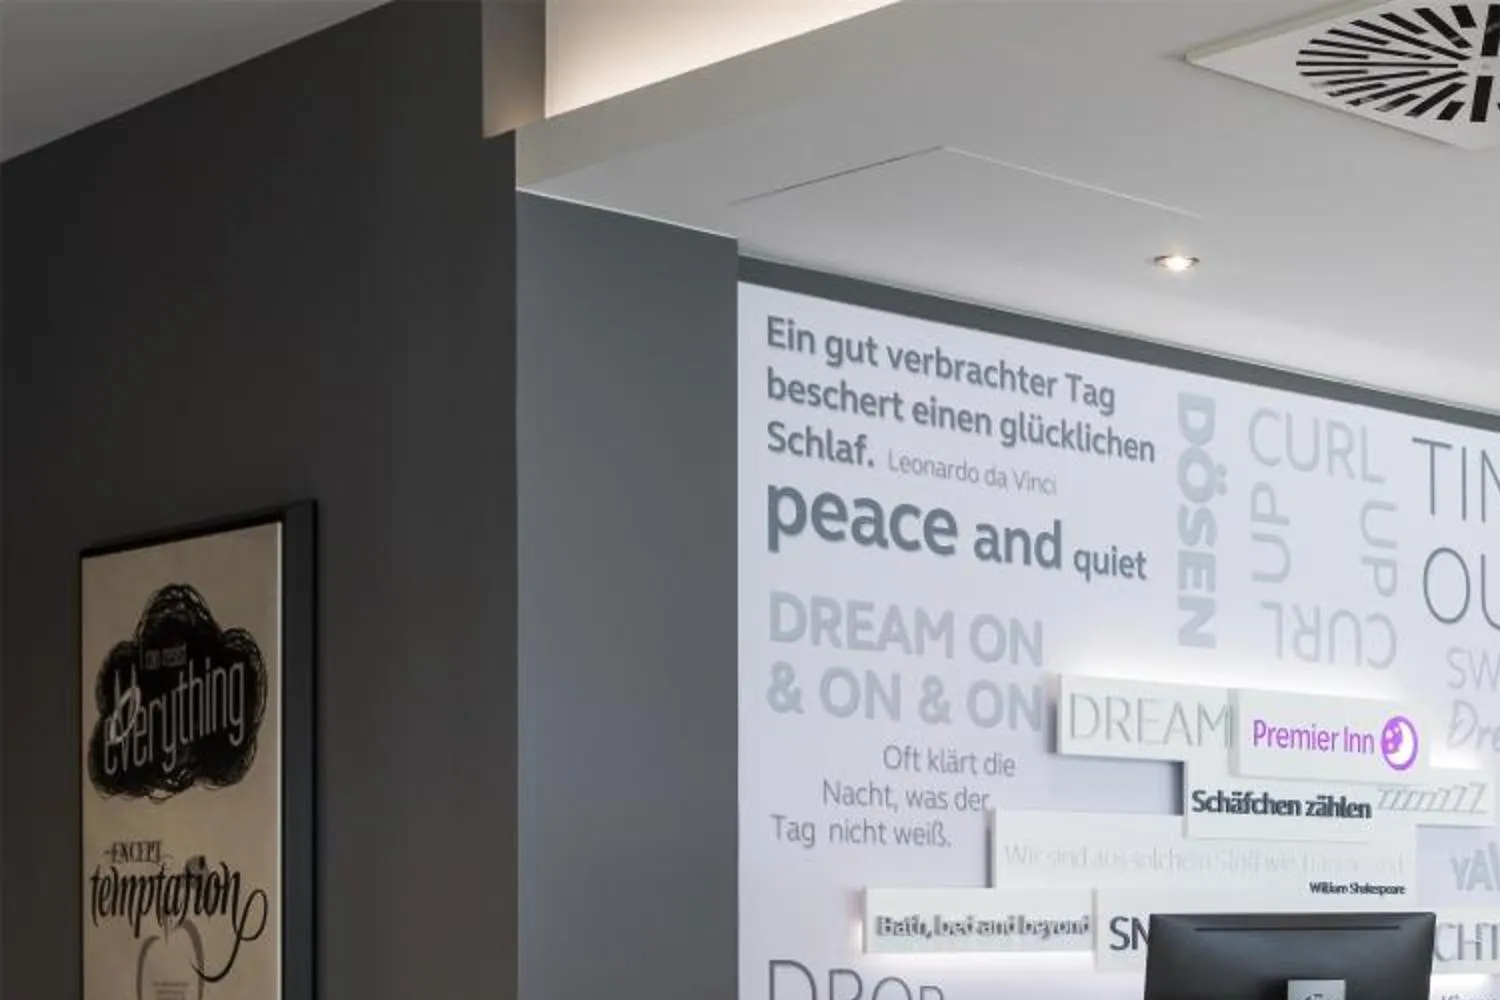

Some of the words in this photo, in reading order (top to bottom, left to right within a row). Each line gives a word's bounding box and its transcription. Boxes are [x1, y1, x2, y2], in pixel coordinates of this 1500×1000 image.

[767, 315, 815, 355] Ein
[825, 336, 879, 367] gut
[887, 347, 1057, 398] verbrachter
[1065, 373, 1115, 415] Tag
[767, 368, 903, 422] beschert
[913, 398, 992, 436] einen
[1000, 412, 1155, 463] glücklichen
[1248, 408, 1387, 484] CURL
[767, 421, 875, 468] Schlaf.
[888, 449, 979, 485] Leonardo
[985, 468, 1008, 489] da
[1013, 472, 1057, 495] Vinci
[767, 484, 957, 556] peace
[973, 520, 1062, 569] and
[1073, 546, 1147, 583] quiet
[1178, 393, 1229, 649] DÖSEN
[1250, 481, 1291, 584] UP
[1360, 499, 1398, 597] UP
[769, 590, 954, 658] DREAM
[969, 615, 1043, 667] ON
[1260, 600, 1398, 669] CURL
[104, 658, 245, 775] everything
[767, 661, 804, 715] &
[820, 666, 901, 722] ON
[918, 675, 951, 726] &
[967, 680, 1043, 732] ON
[1070, 692, 1233, 749] DREAM
[883, 745, 920, 771] Oft
[927, 747, 977, 776] klärt
[984, 751, 1016, 777] die
[1253, 718, 1341, 753] Premier
[1344, 726, 1374, 755] Inn
[771, 814, 815, 849] Tag
[829, 817, 887, 845] nicht
[893, 822, 952, 848] weiß.
[822, 780, 898, 812] Nacht,
[905, 790, 948, 811] was
[954, 787, 990, 811] der
[1191, 789, 1301, 817] Schäfchen
[1305, 794, 1372, 819] zählen
[90, 855, 268, 965] temptation
[1309, 881, 1348, 894] William
